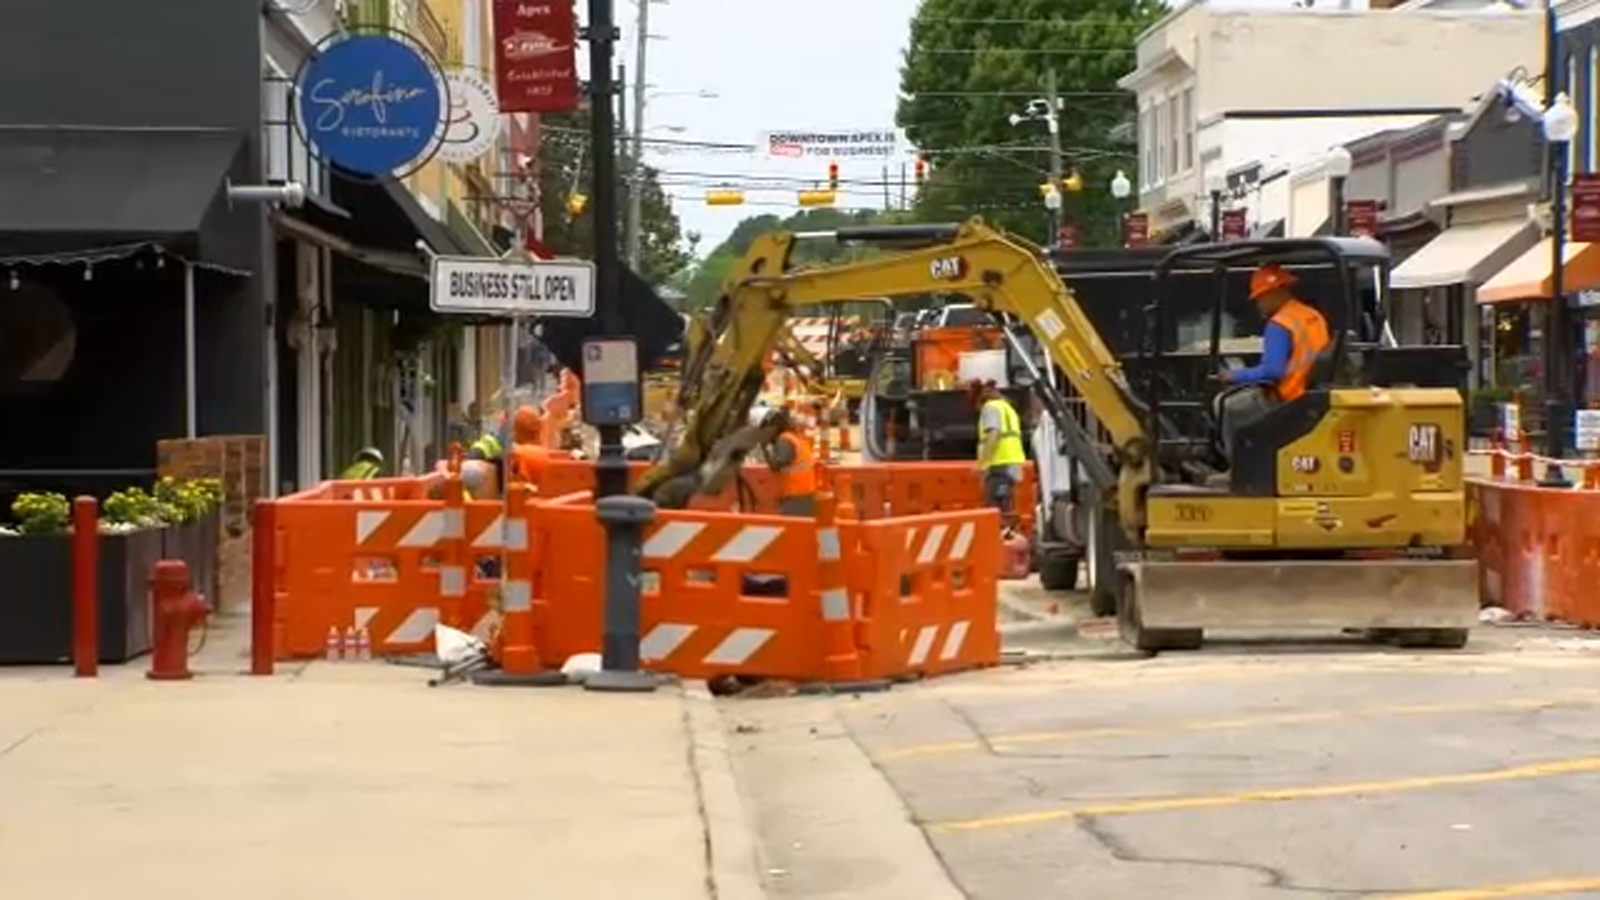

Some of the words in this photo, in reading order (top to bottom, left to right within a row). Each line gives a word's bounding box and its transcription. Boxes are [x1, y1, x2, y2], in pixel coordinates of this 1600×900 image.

[310, 70, 428, 132] Serafina
[769, 133, 849, 144] DOWNTOWN
[851, 132, 883, 143] APEX
[930, 256, 960, 280] CAT
[449, 271, 508, 299] BUSINESS
[511, 272, 542, 300] STILL
[544, 275, 576, 301] OPEN
[1408, 425, 1438, 462] CAT
[1291, 456, 1315, 471] CAT
